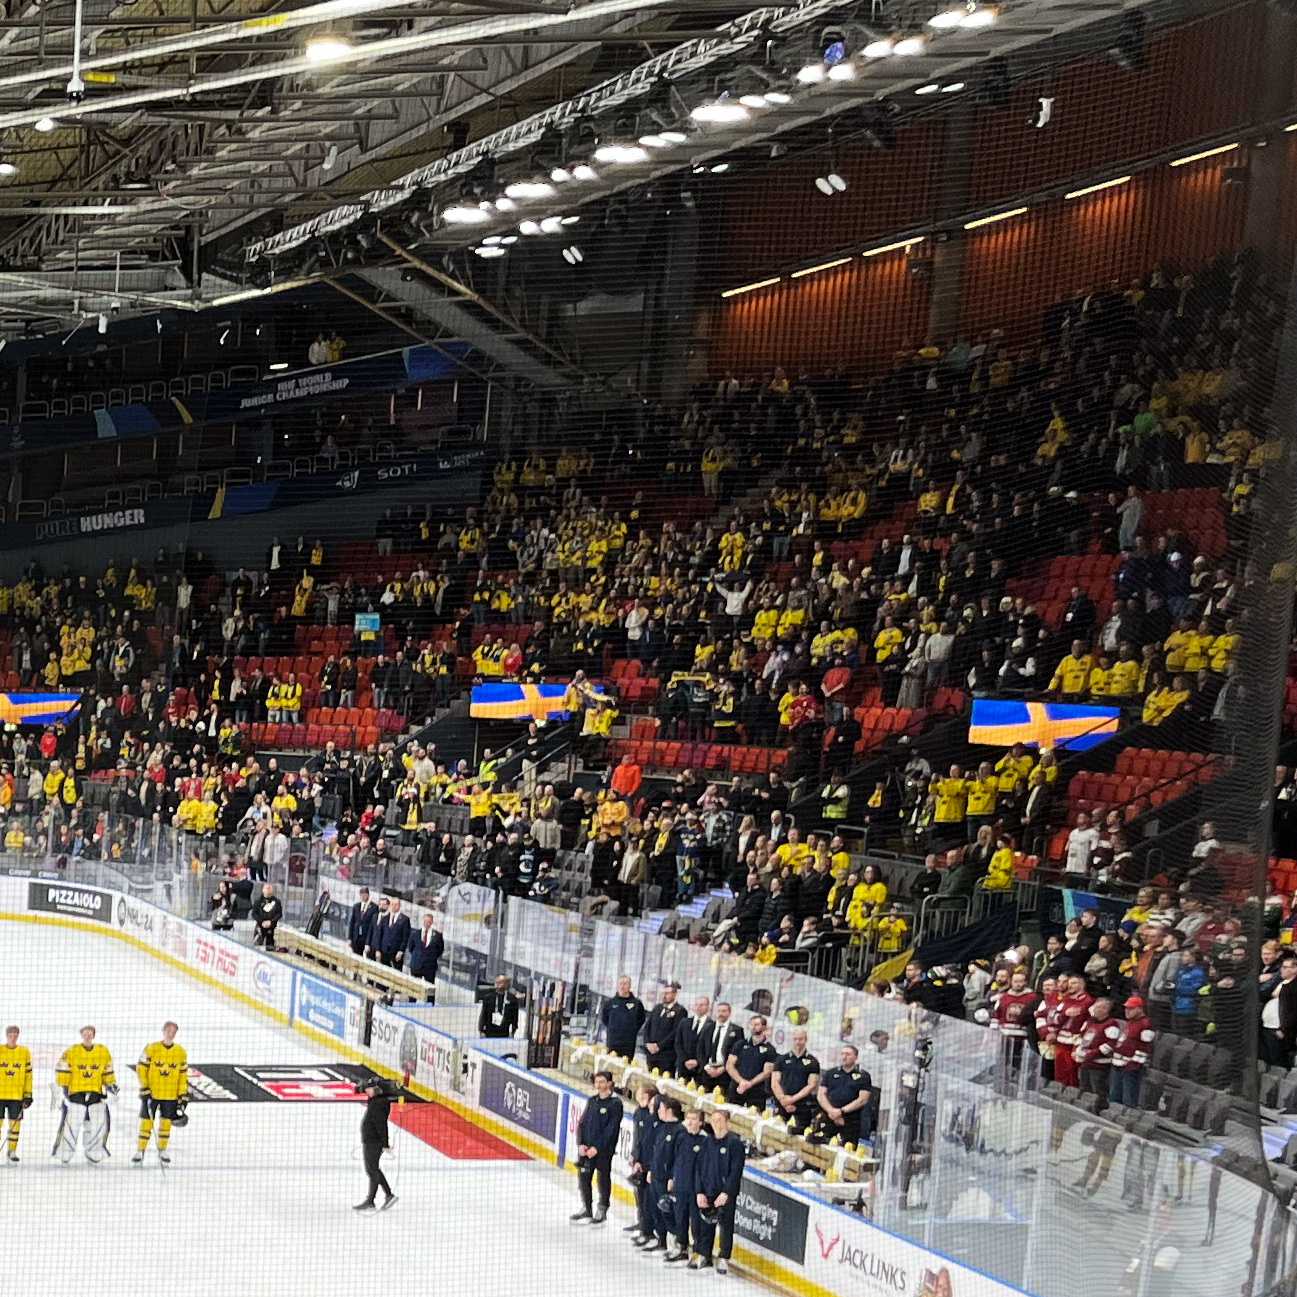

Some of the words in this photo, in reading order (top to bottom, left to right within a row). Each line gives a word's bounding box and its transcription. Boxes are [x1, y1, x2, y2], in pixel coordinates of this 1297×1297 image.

[378, 464, 417, 480] SOTI
[81, 509, 145, 532] HUNGER
[372, 1017, 398, 1047] SSOT
[839, 1239, 869, 1276] JACK
